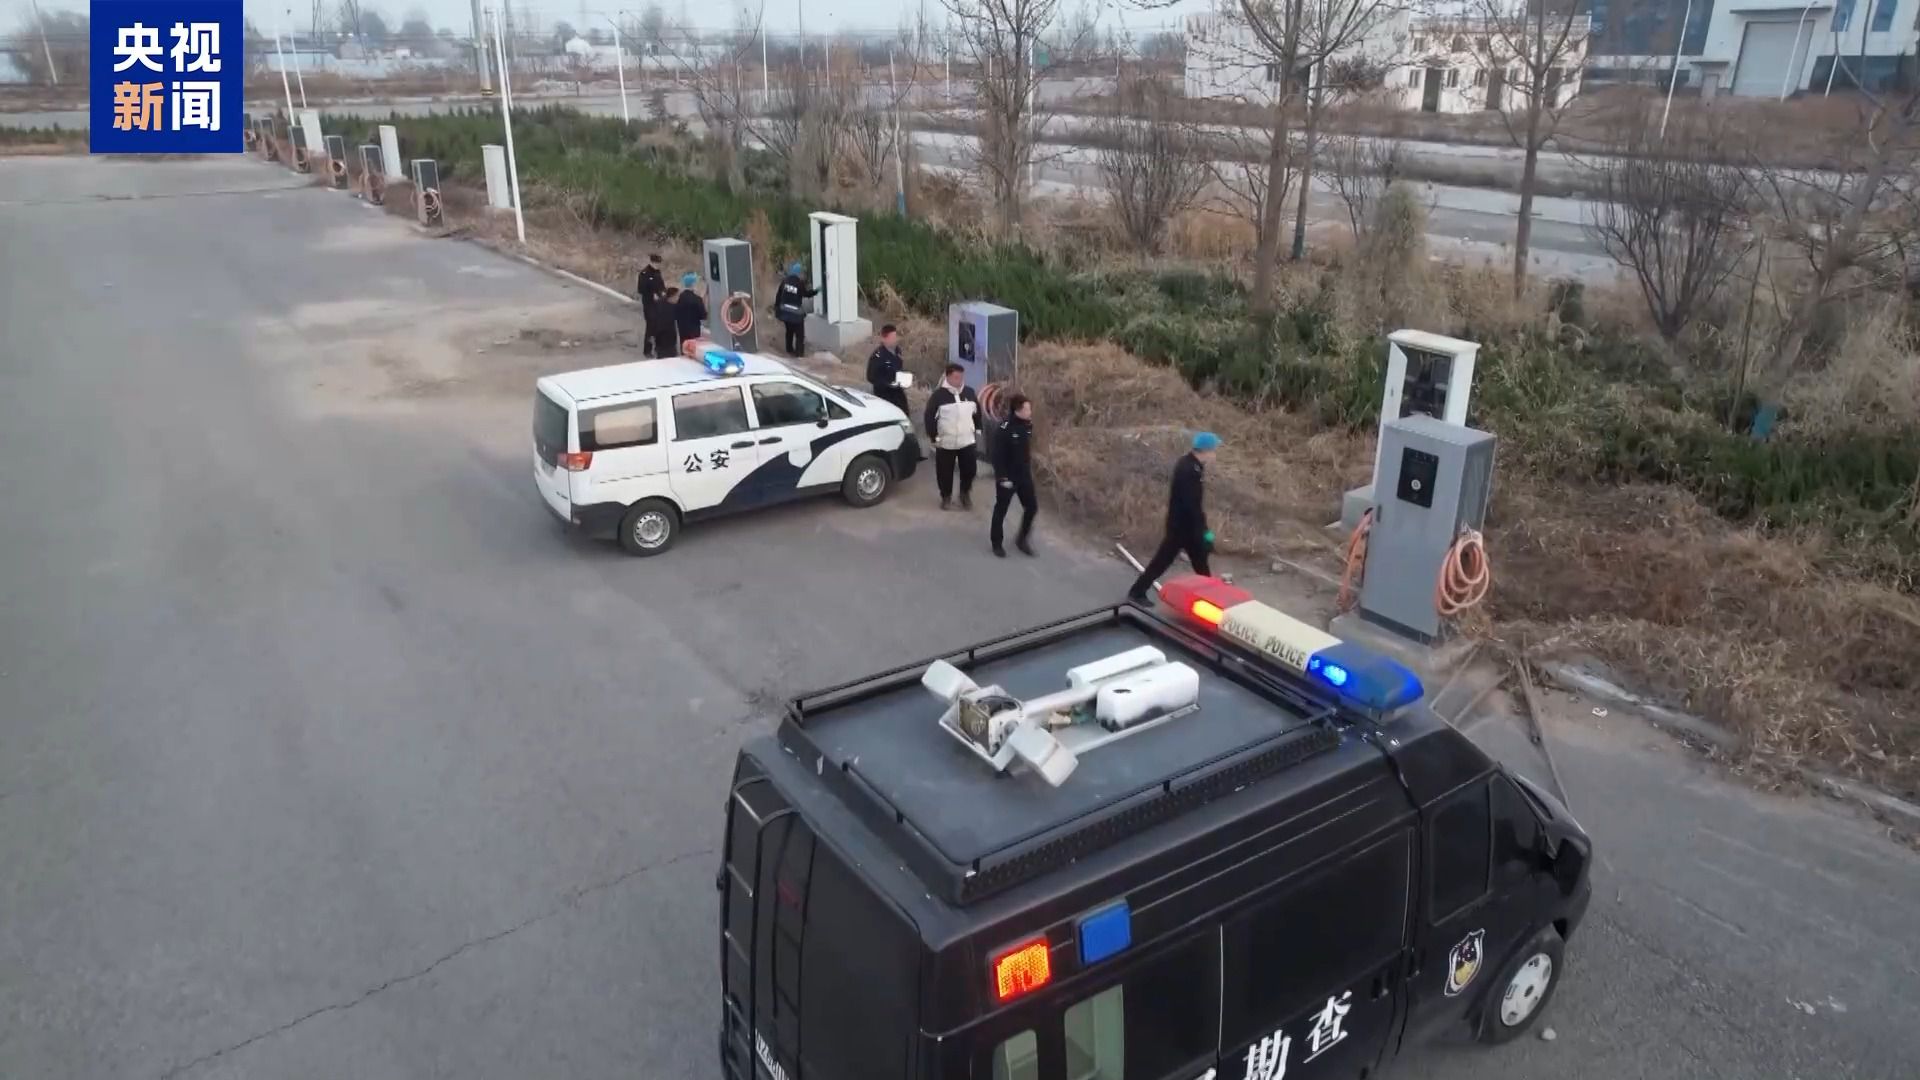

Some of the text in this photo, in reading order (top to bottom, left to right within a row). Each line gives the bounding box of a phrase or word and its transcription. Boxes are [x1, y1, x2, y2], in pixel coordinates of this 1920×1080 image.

[683, 449, 730, 473] 公安
[1222, 618, 1307, 667] POLICE POLICE
